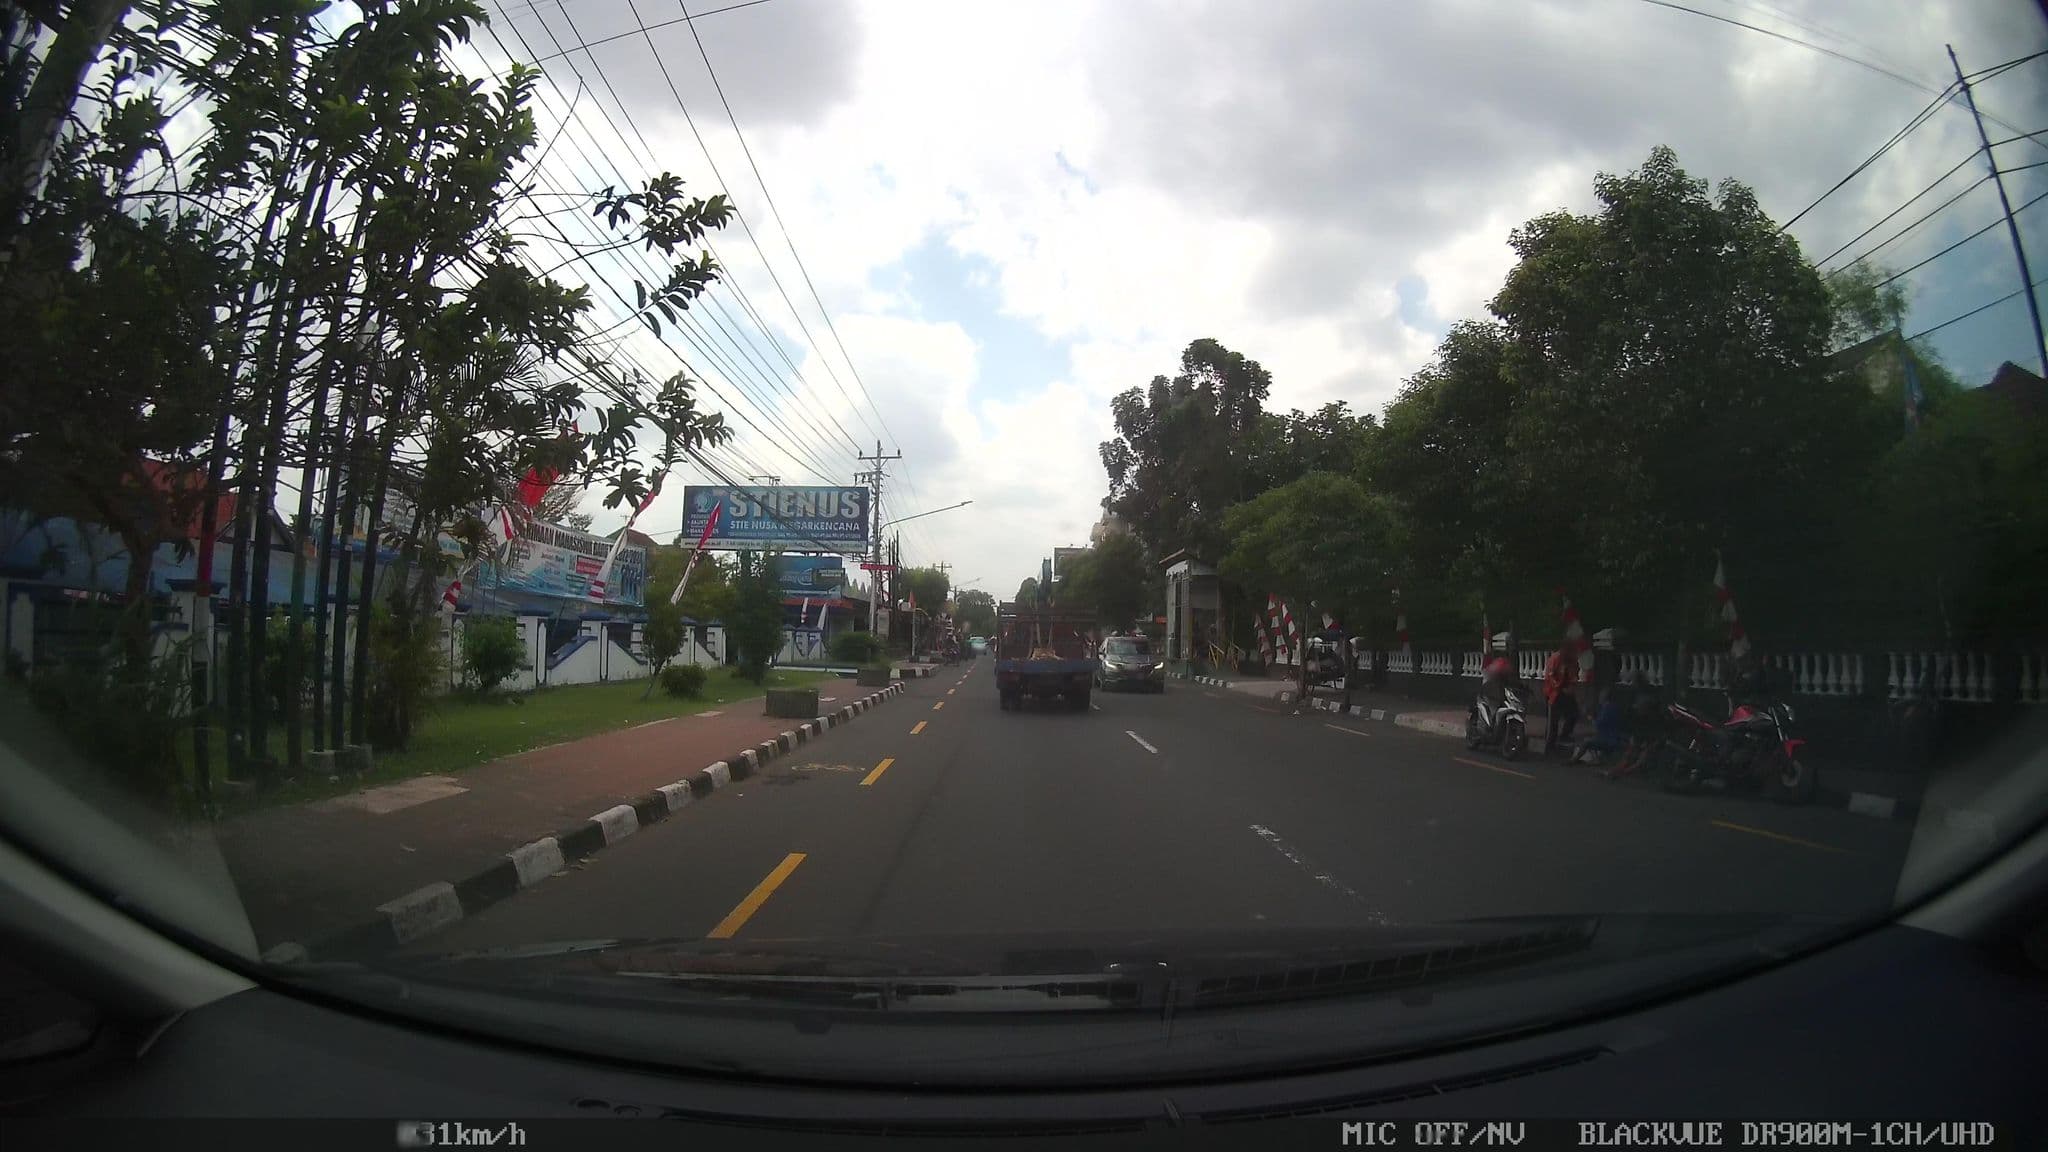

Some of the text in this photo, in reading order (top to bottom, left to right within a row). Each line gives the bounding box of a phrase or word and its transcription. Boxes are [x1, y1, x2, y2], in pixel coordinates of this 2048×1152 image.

[729, 491, 861, 518] STIENUS
[730, 520, 749, 530] STIE
[752, 520, 778, 531] NUSA
